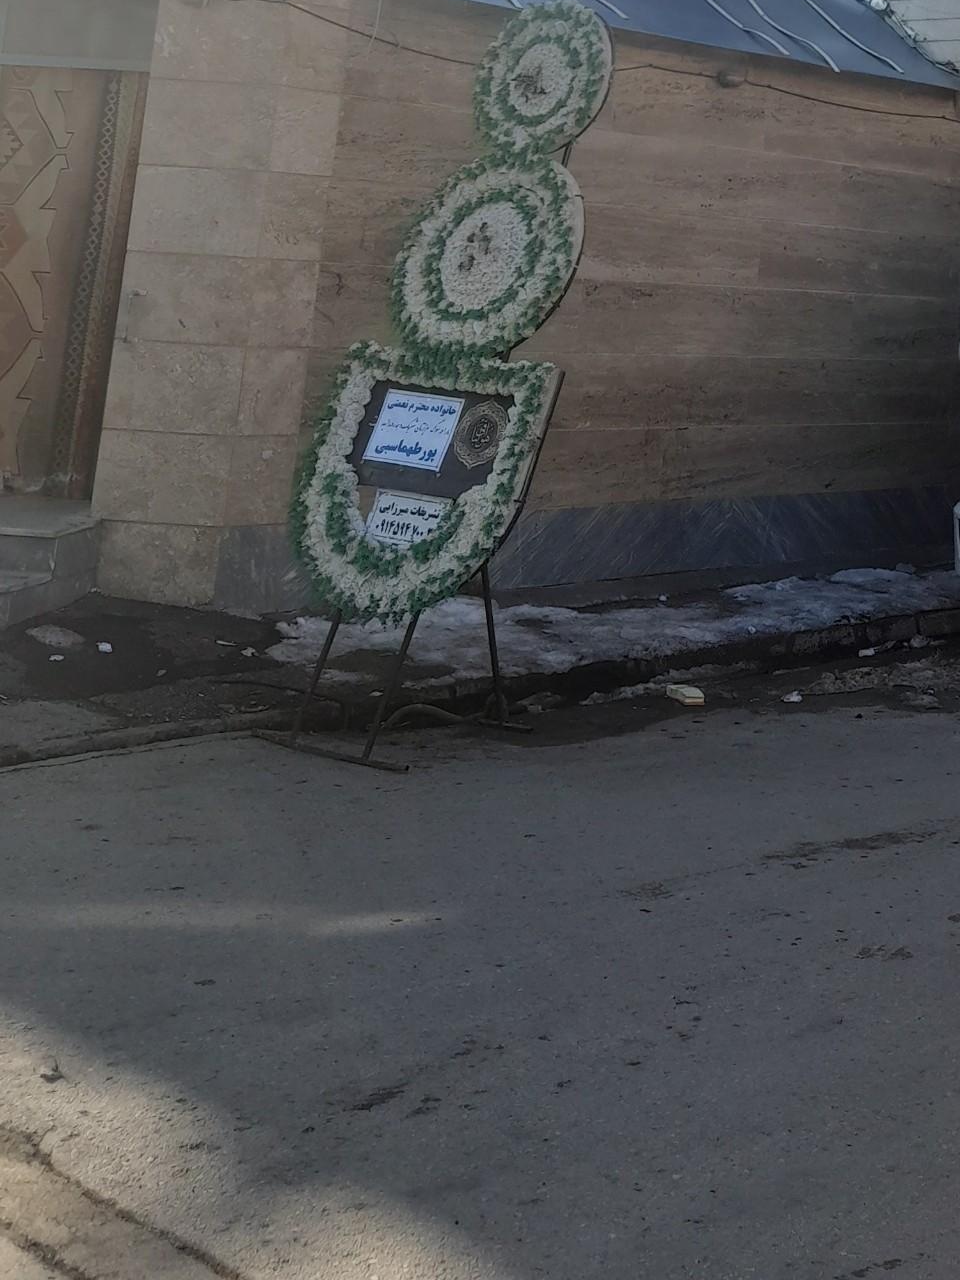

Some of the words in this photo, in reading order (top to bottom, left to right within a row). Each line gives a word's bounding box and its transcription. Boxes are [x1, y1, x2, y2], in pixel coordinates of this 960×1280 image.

[408, 402, 429, 413] محترم
[430, 404, 456, 417] خانواده
[410, 505, 440, 521] تشریفات
